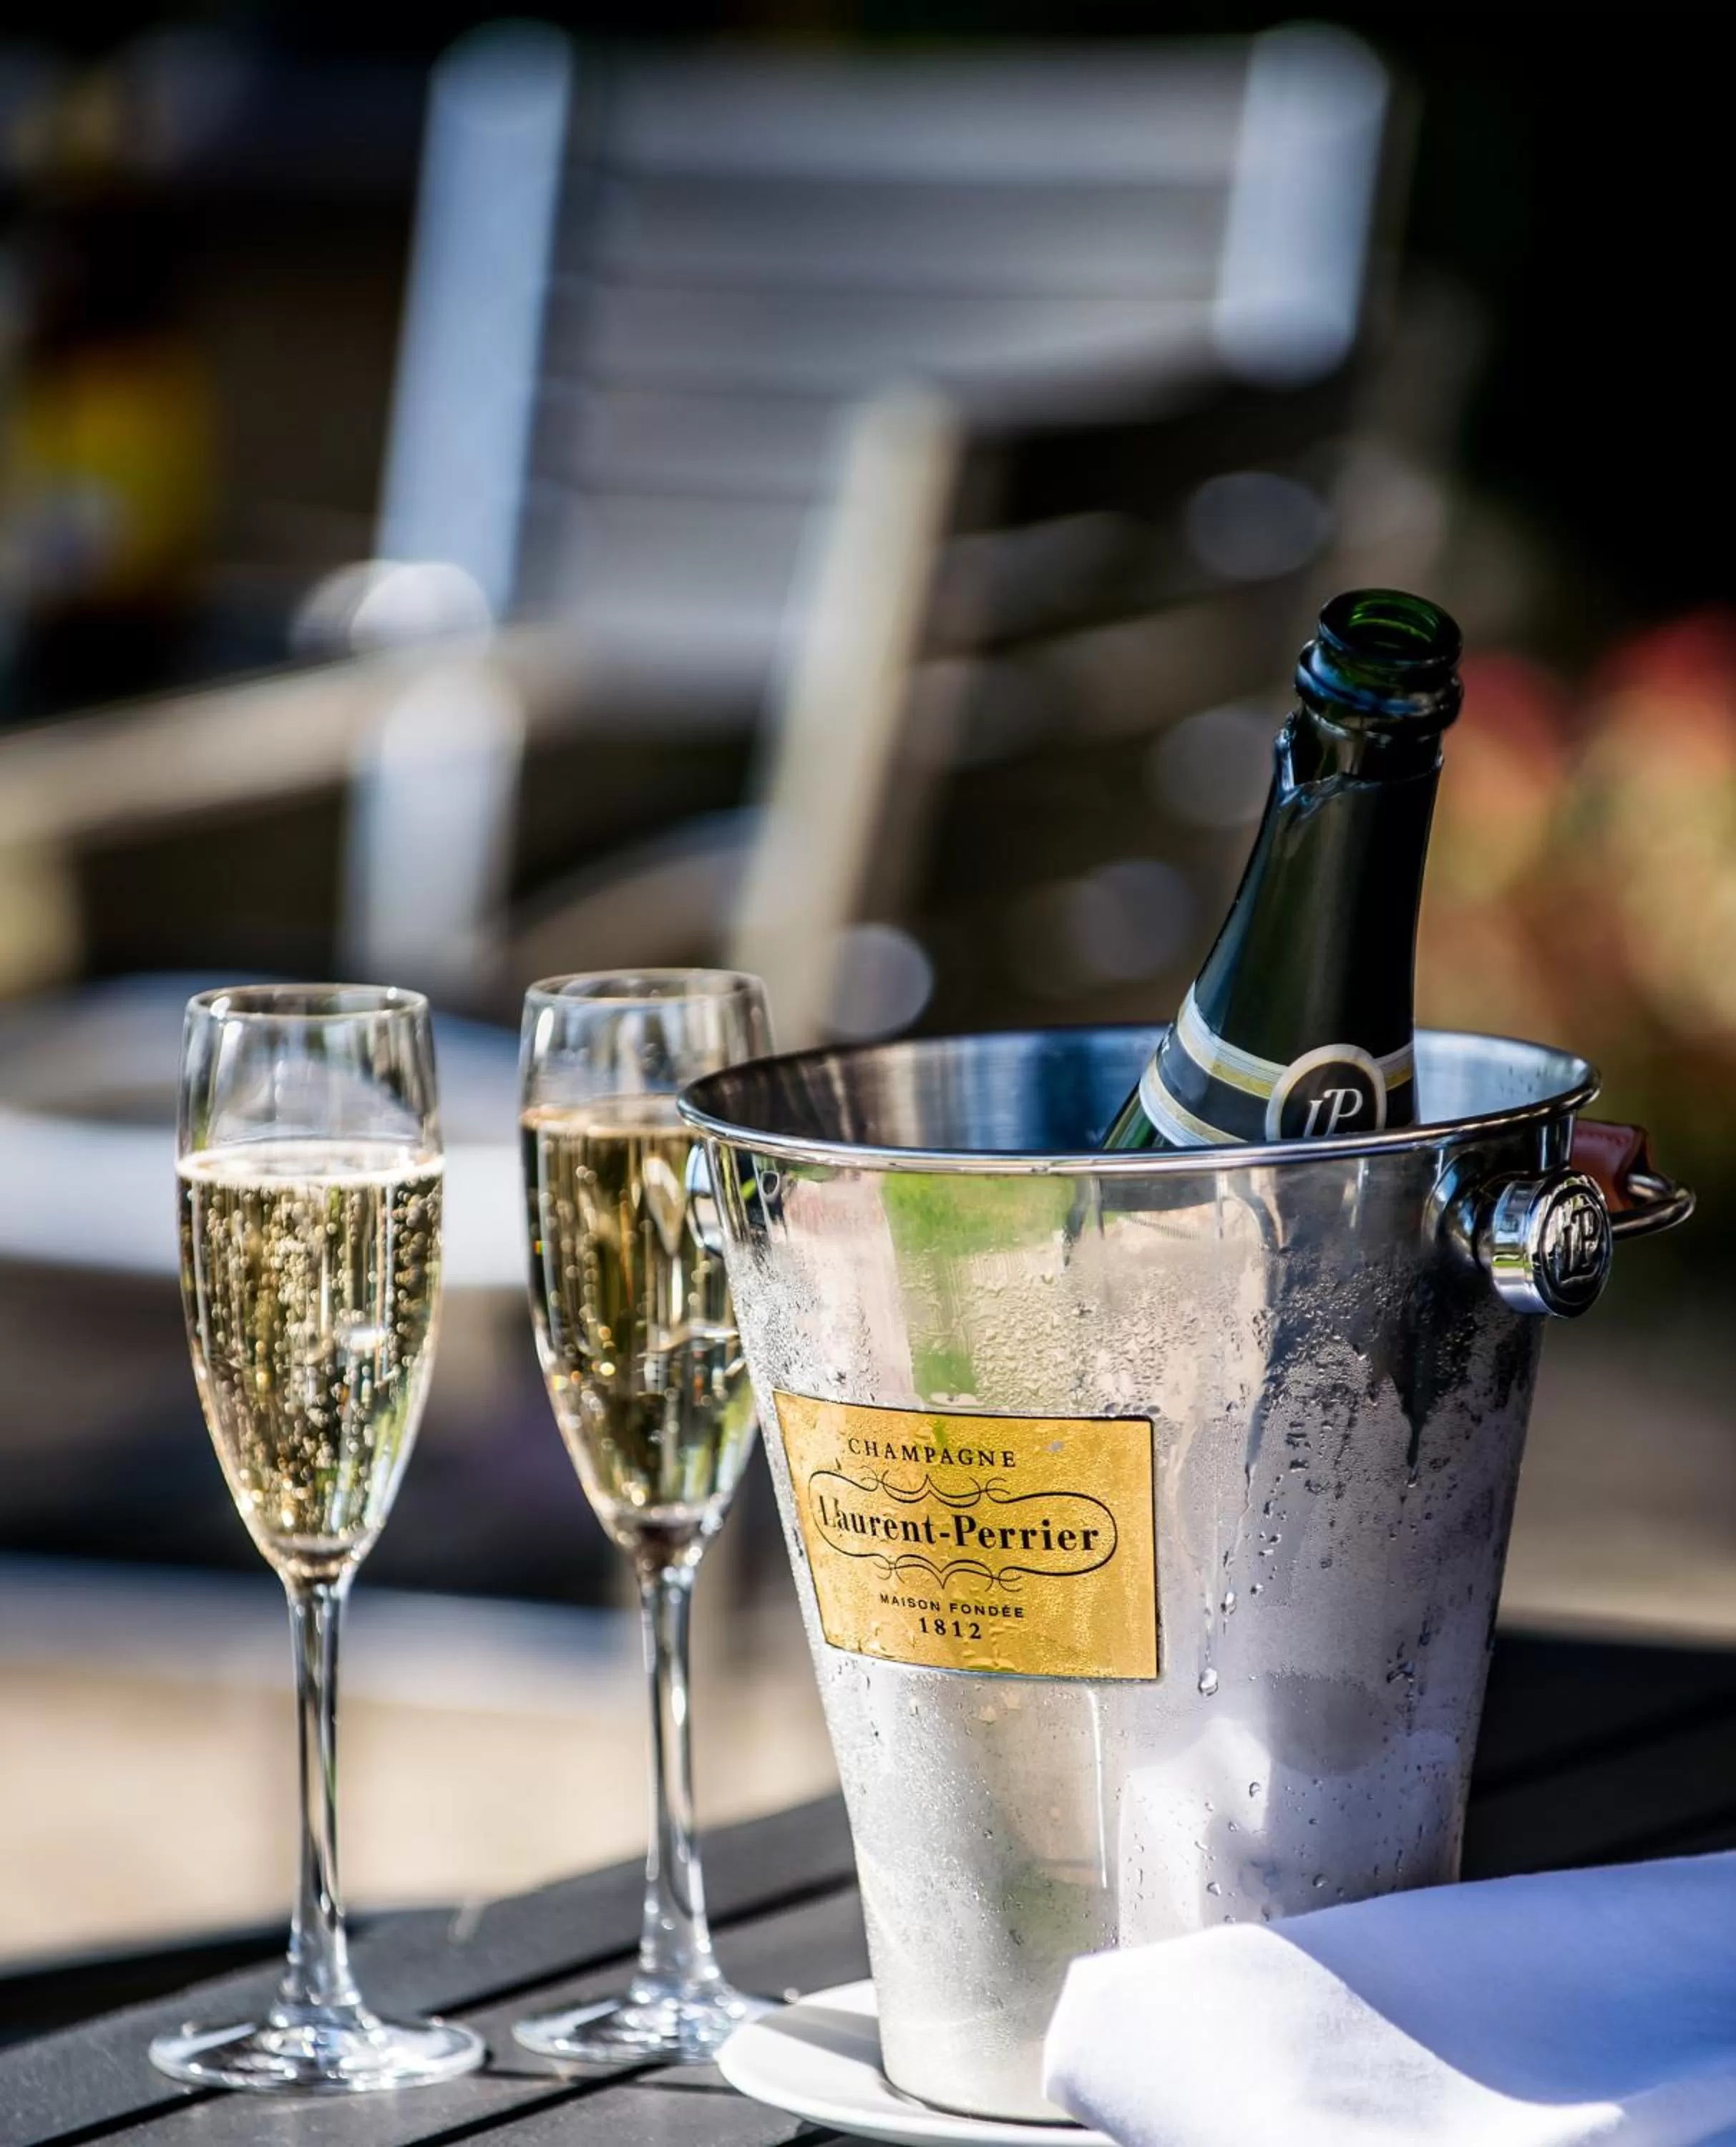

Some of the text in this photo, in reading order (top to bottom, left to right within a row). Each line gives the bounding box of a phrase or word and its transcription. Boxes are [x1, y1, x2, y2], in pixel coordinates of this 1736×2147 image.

[847, 1438, 1017, 1469] CHAMPAGNE
[818, 1495, 1100, 1552] Laurent-Perrier
[879, 1594, 1025, 1619] MAISON FONDÉE
[919, 1617, 982, 1640] 1812
